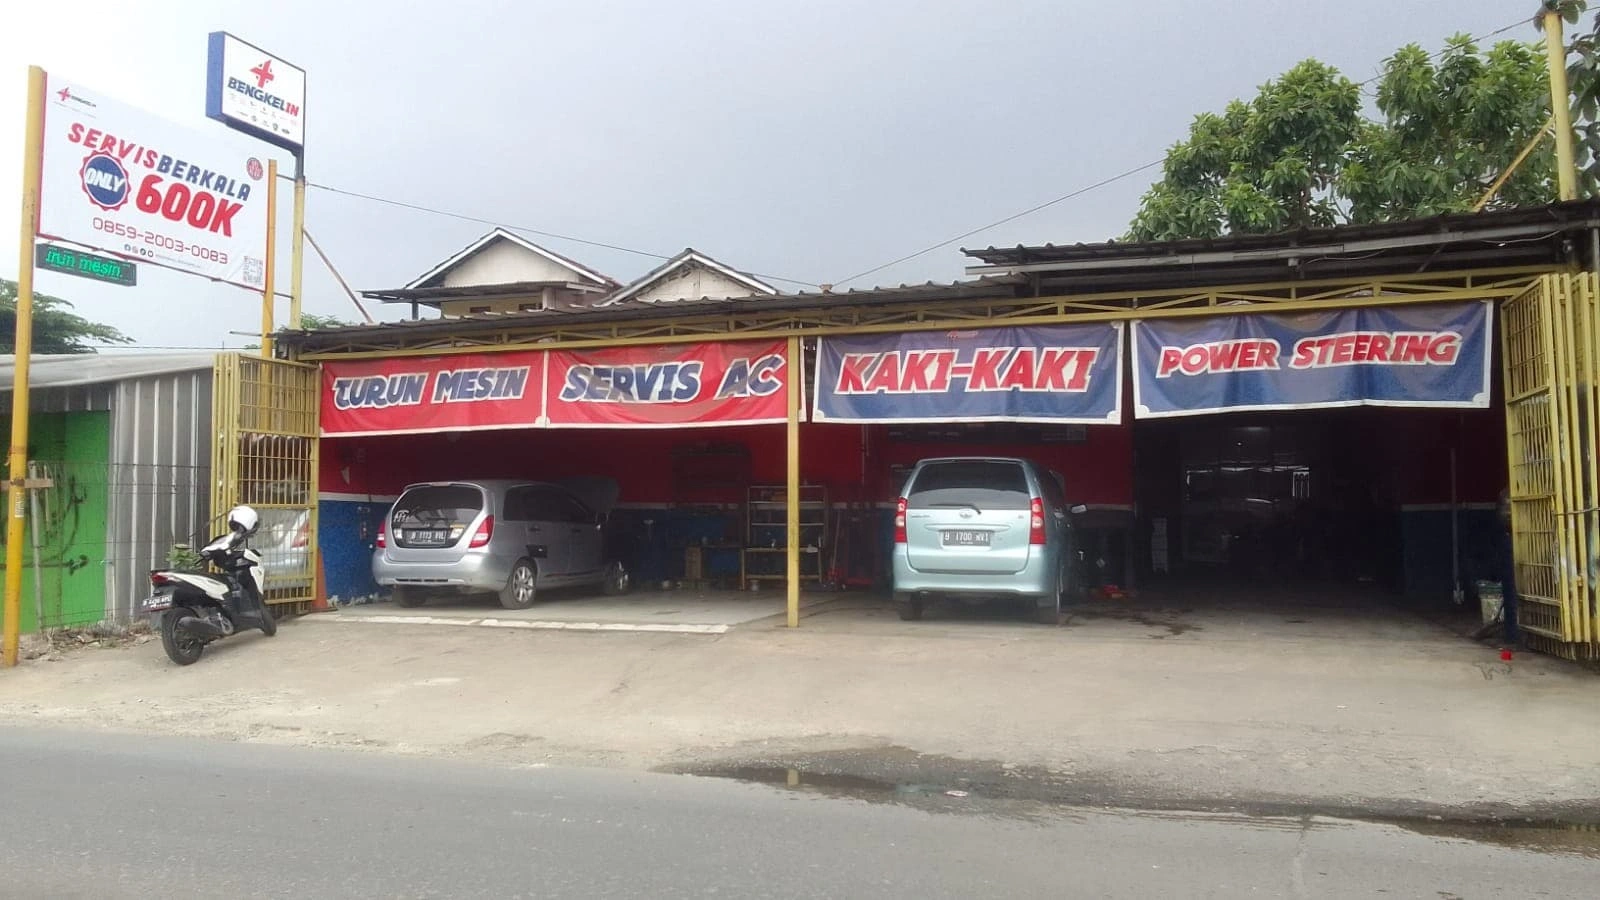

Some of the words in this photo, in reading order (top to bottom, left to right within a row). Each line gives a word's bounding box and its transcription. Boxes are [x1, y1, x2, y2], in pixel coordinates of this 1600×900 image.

[227, 76, 299, 117] BENGKELIN
[85, 167, 125, 192] ONLY
[136, 174, 243, 237] 600K
[92, 217, 228, 264] 0859-2003-0083
[833, 347, 1100, 394] KAKI-KAKI
[1156, 338, 1280, 378] POWER
[1289, 330, 1463, 369] STEERING
[332, 372, 428, 410] TURUN
[432, 366, 530, 403] MESIN
[559, 361, 703, 402] SERVIS
[715, 354, 786, 400] AC
